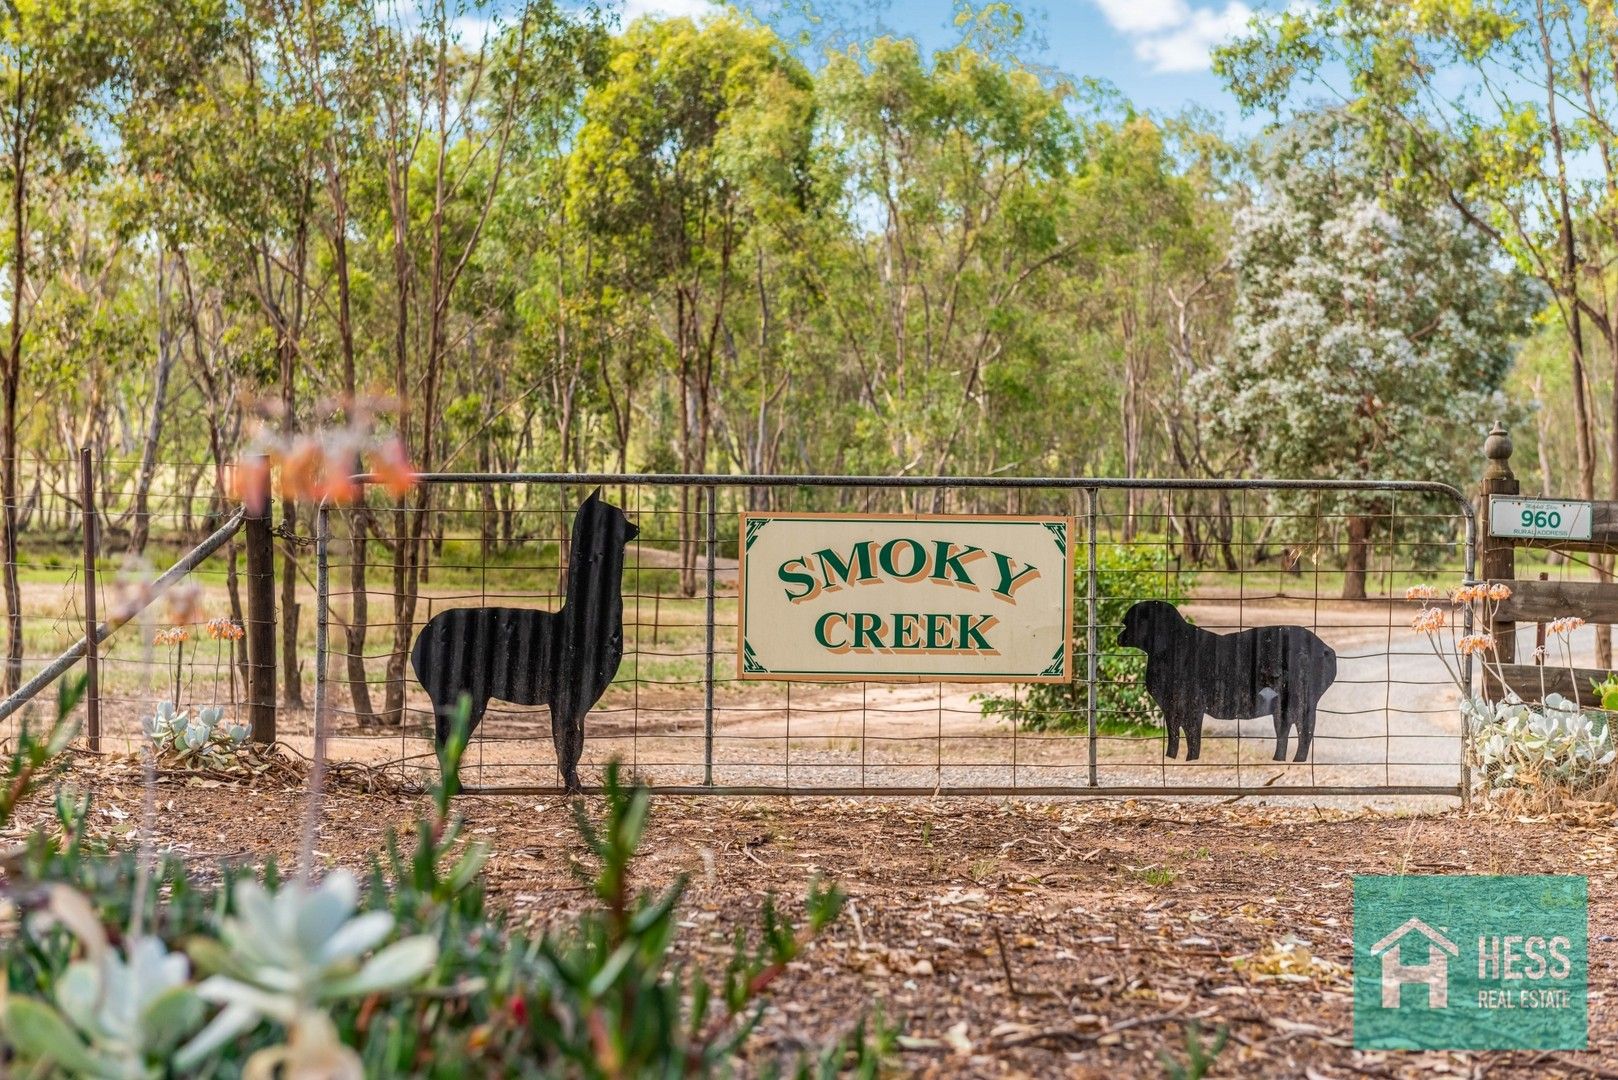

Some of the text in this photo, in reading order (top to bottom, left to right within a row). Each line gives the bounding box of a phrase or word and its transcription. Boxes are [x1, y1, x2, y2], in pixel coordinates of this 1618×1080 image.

[1521, 510, 1561, 529] 960
[778, 538, 1041, 605] SMOKY
[814, 611, 1001, 656] CREEK
